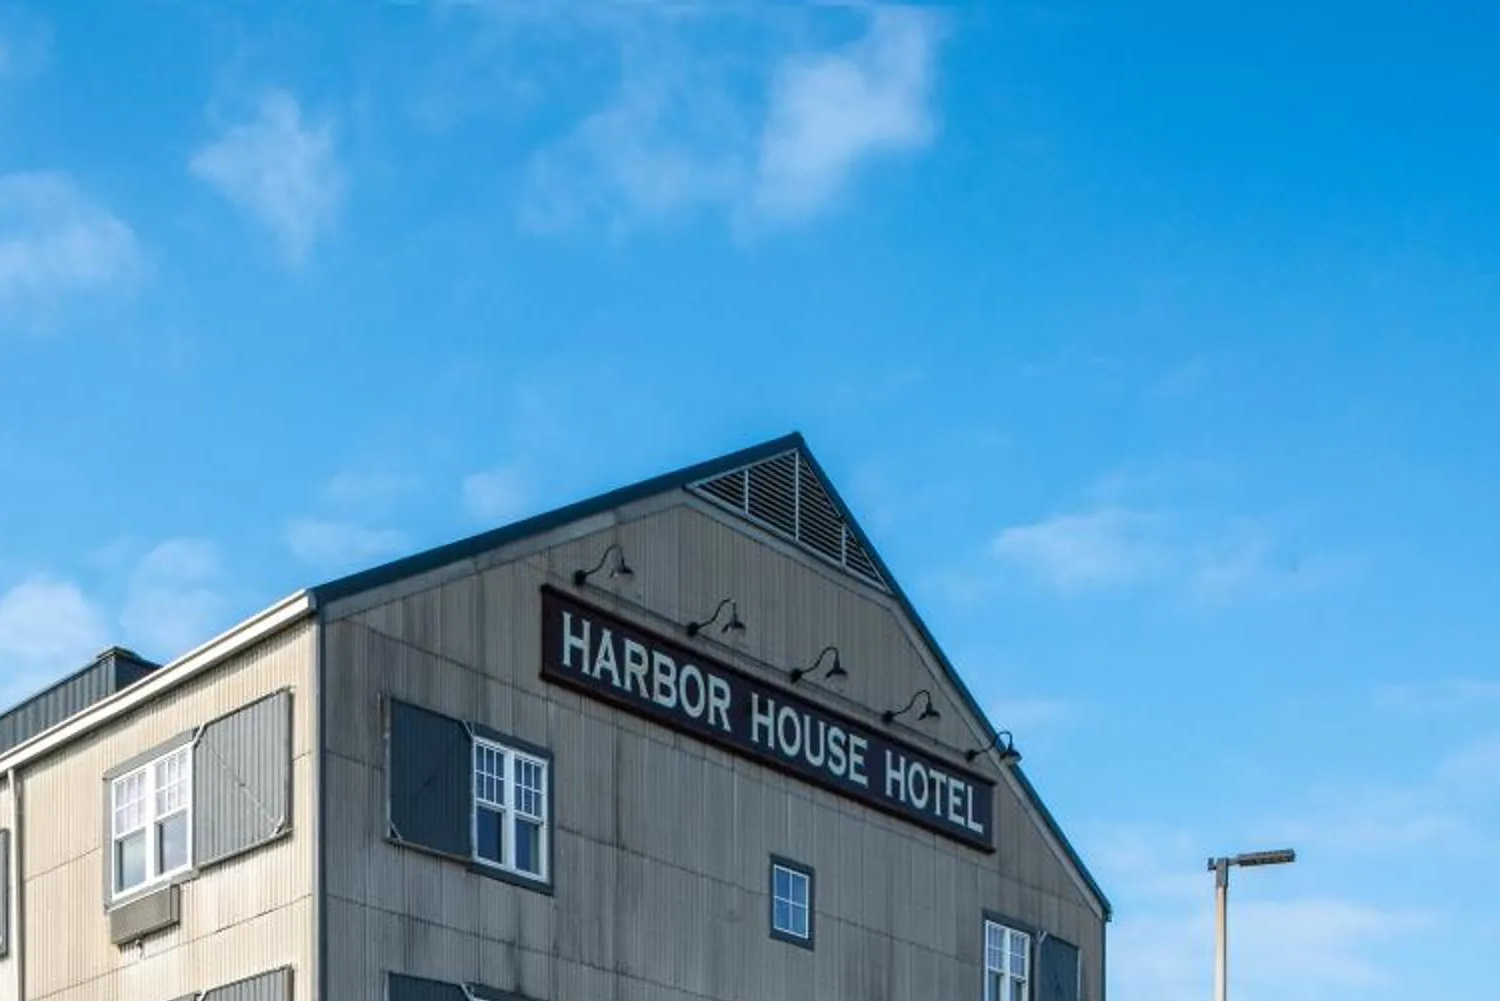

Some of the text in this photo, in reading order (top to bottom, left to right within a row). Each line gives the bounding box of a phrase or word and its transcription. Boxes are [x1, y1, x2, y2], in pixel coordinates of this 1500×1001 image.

[562, 611, 984, 834] HARBOR HOUSE HOTEL
